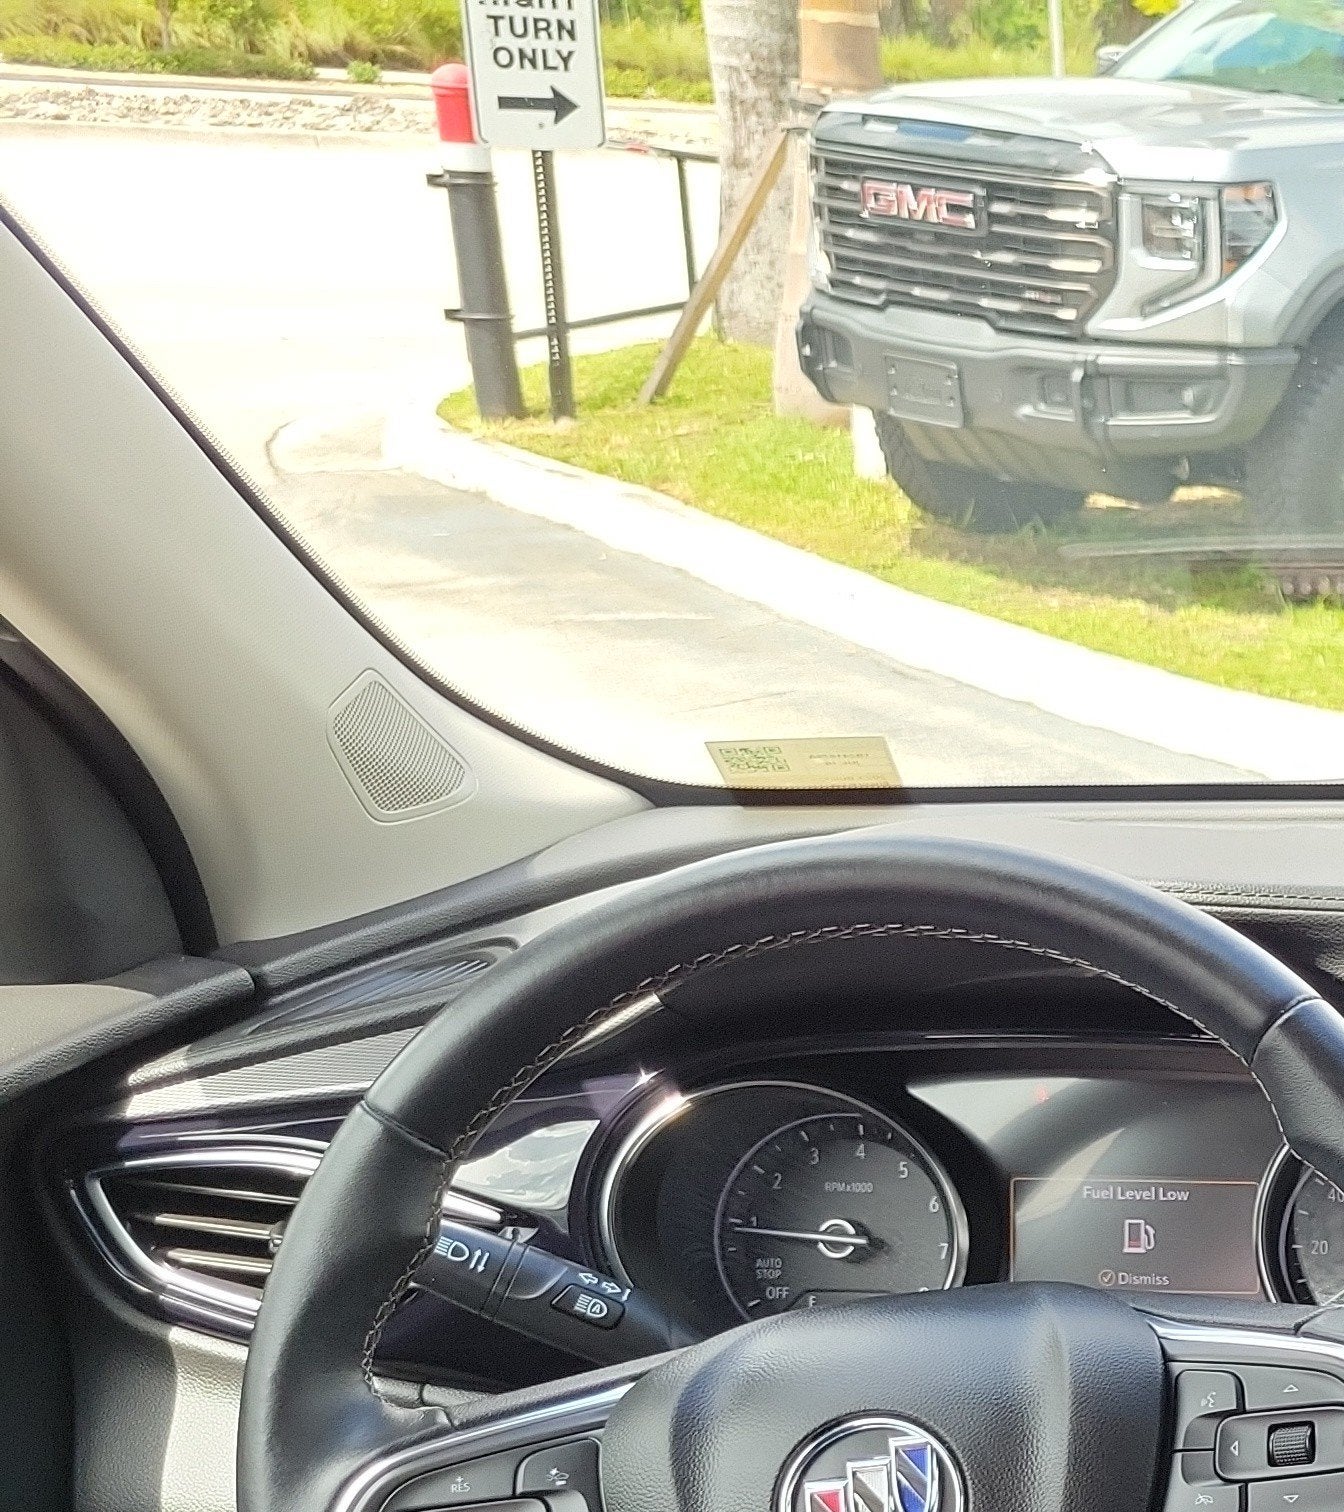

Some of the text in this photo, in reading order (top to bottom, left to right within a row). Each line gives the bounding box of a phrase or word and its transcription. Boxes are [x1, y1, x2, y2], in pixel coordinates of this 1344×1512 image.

[486, 15, 576, 41] TURN
[493, 46, 575, 72] ONLY
[861, 179, 976, 230] GMC
[811, 1148, 820, 1165] 3
[855, 1143, 866, 1160] 4
[899, 1161, 909, 1179] 5
[771, 1172, 783, 1190] 2
[1083, 1185, 1190, 1201] Fuel Level Low
[929, 1196, 940, 1213] 6
[1311, 1240, 1329, 1255] 20
[756, 1258, 783, 1269] AUTO
[756, 1269, 782, 1279] STOP
[1118, 1272, 1170, 1286] Dismiss
[765, 1285, 790, 1299] OFF
[450, 1482, 471, 1494] RES
